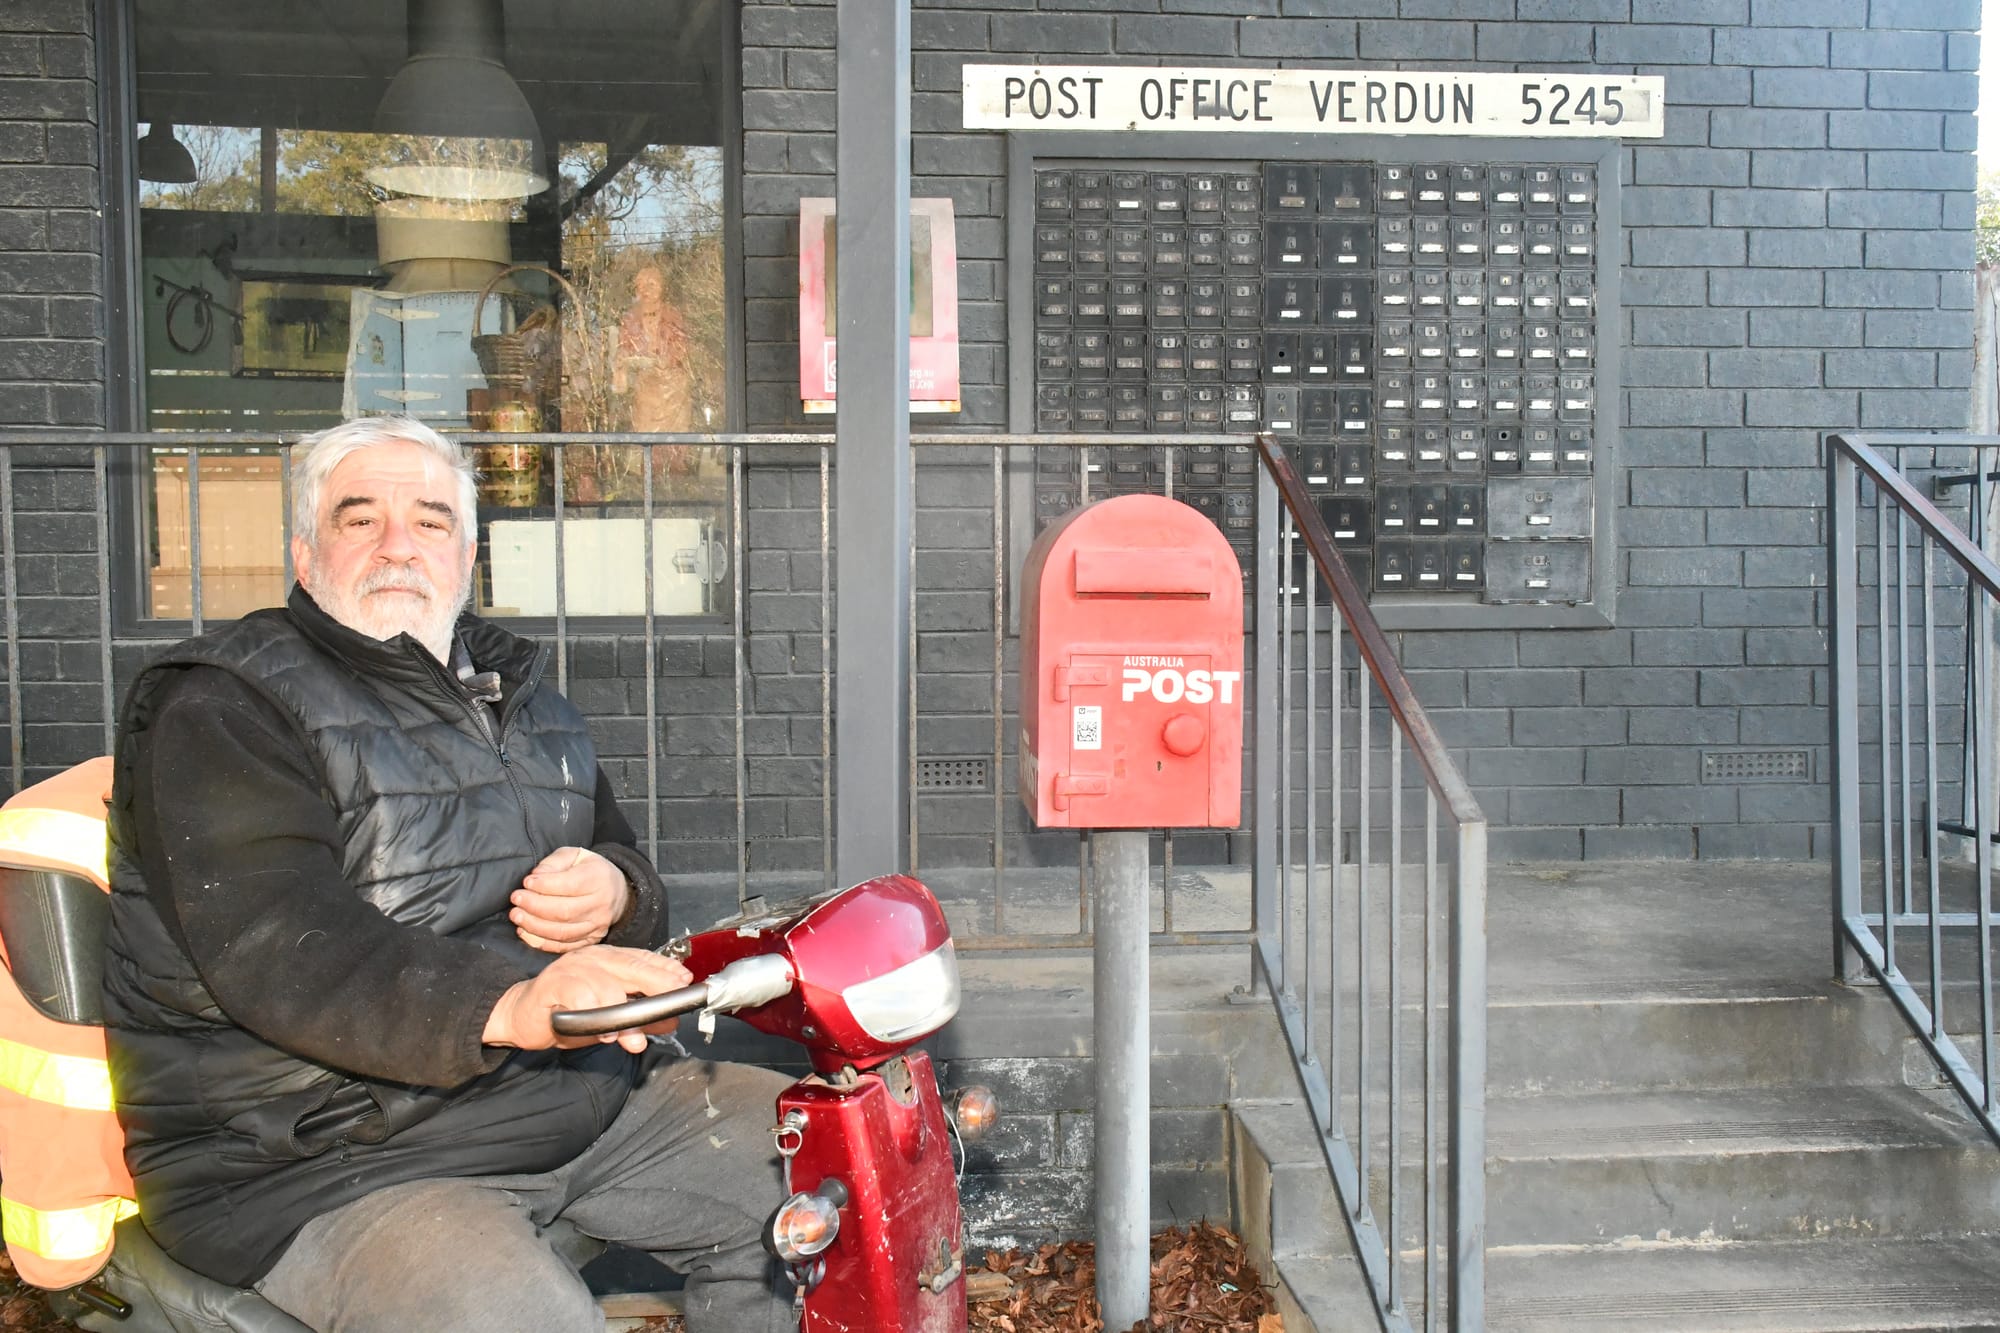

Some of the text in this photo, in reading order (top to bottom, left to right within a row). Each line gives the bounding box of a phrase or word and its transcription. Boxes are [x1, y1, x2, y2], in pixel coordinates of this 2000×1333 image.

[1004, 76, 1624, 126] POST OFFICE VERDUN 5245
[1123, 655, 1184, 668] AUSTRALIA
[1122, 668, 1241, 705] POST
